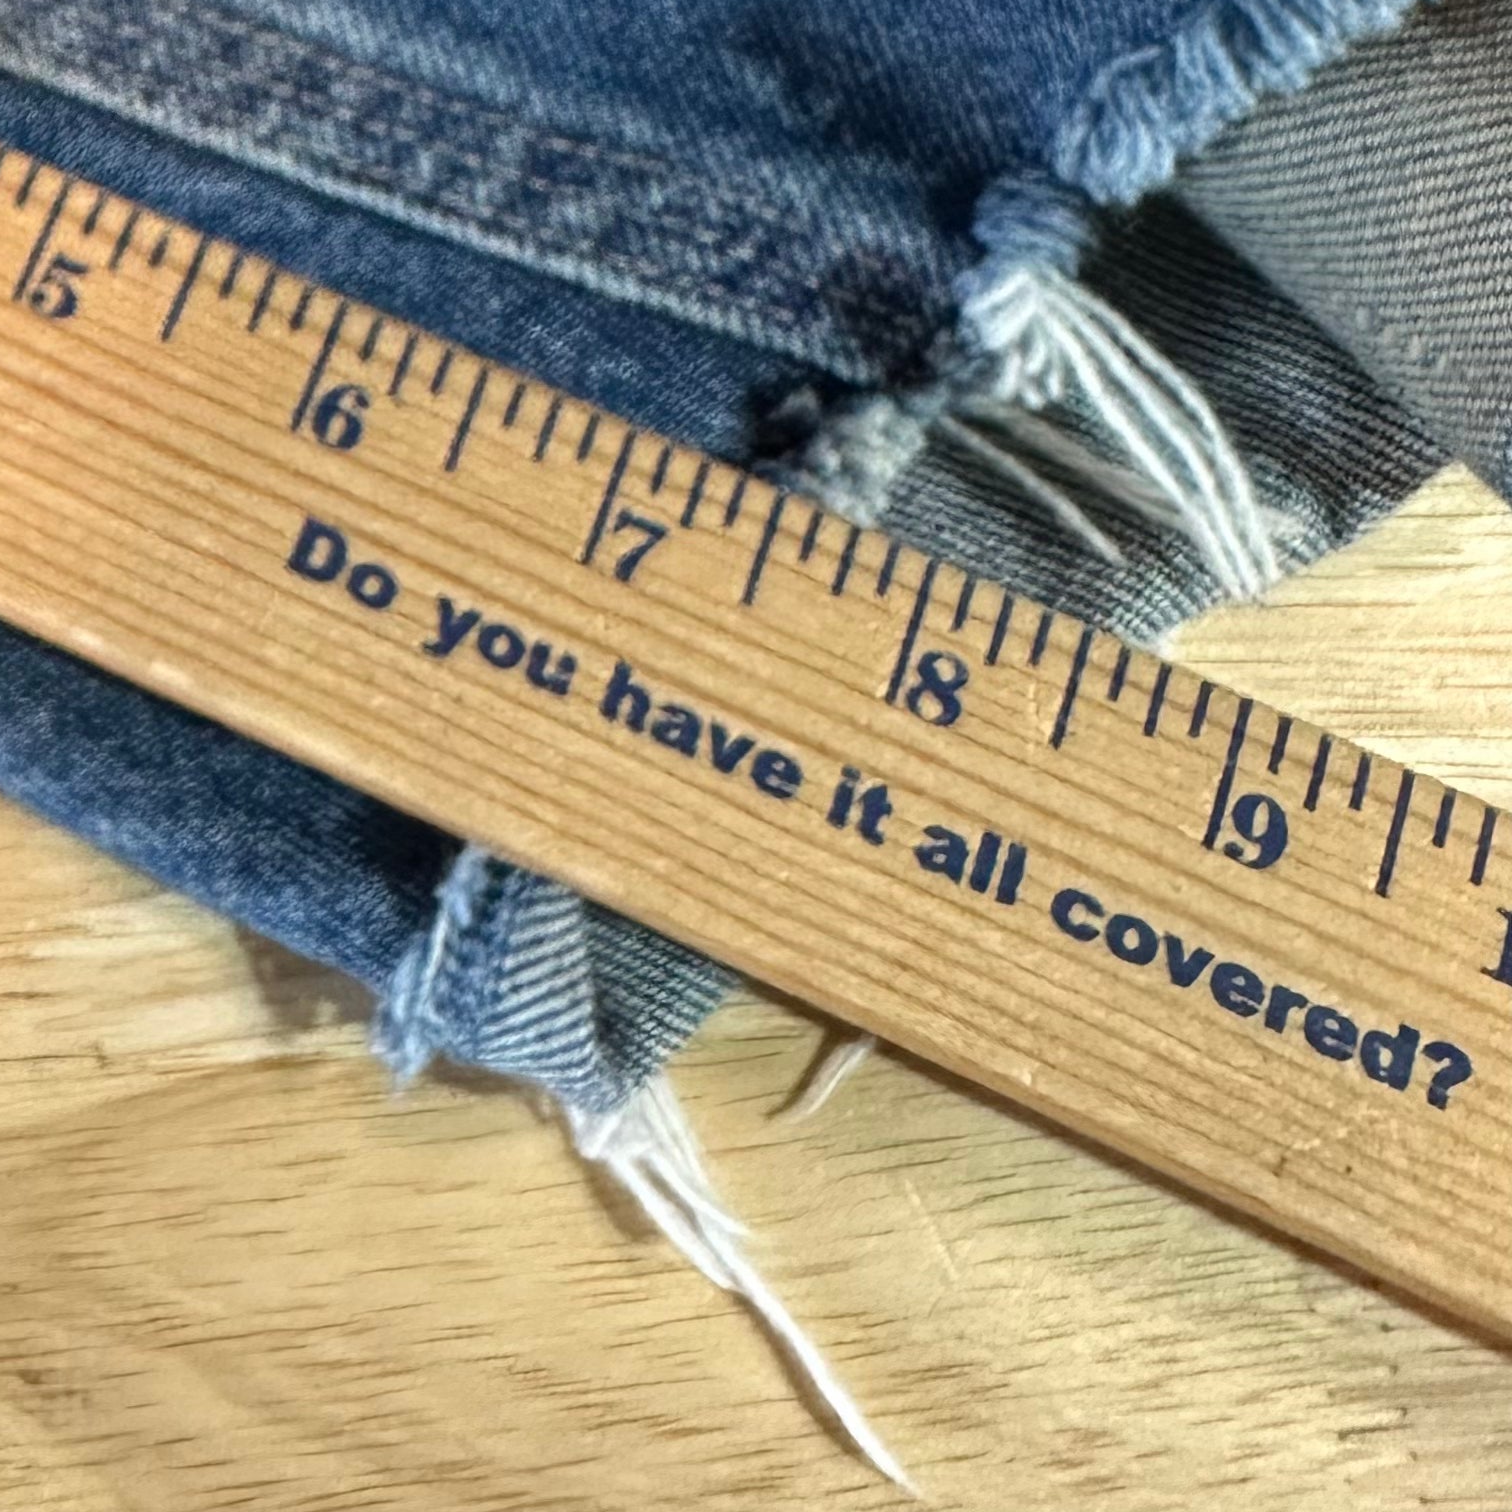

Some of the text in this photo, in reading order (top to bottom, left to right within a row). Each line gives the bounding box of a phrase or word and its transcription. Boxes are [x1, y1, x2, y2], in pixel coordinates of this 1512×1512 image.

[28, 254, 88, 319] 5
[311, 384, 371, 450] 6
[614, 509, 670, 582] 7
[905, 651, 971, 727] 8
[1223, 792, 1289, 870] 9
[287, 516, 1474, 1111] Do you have it all covered?
